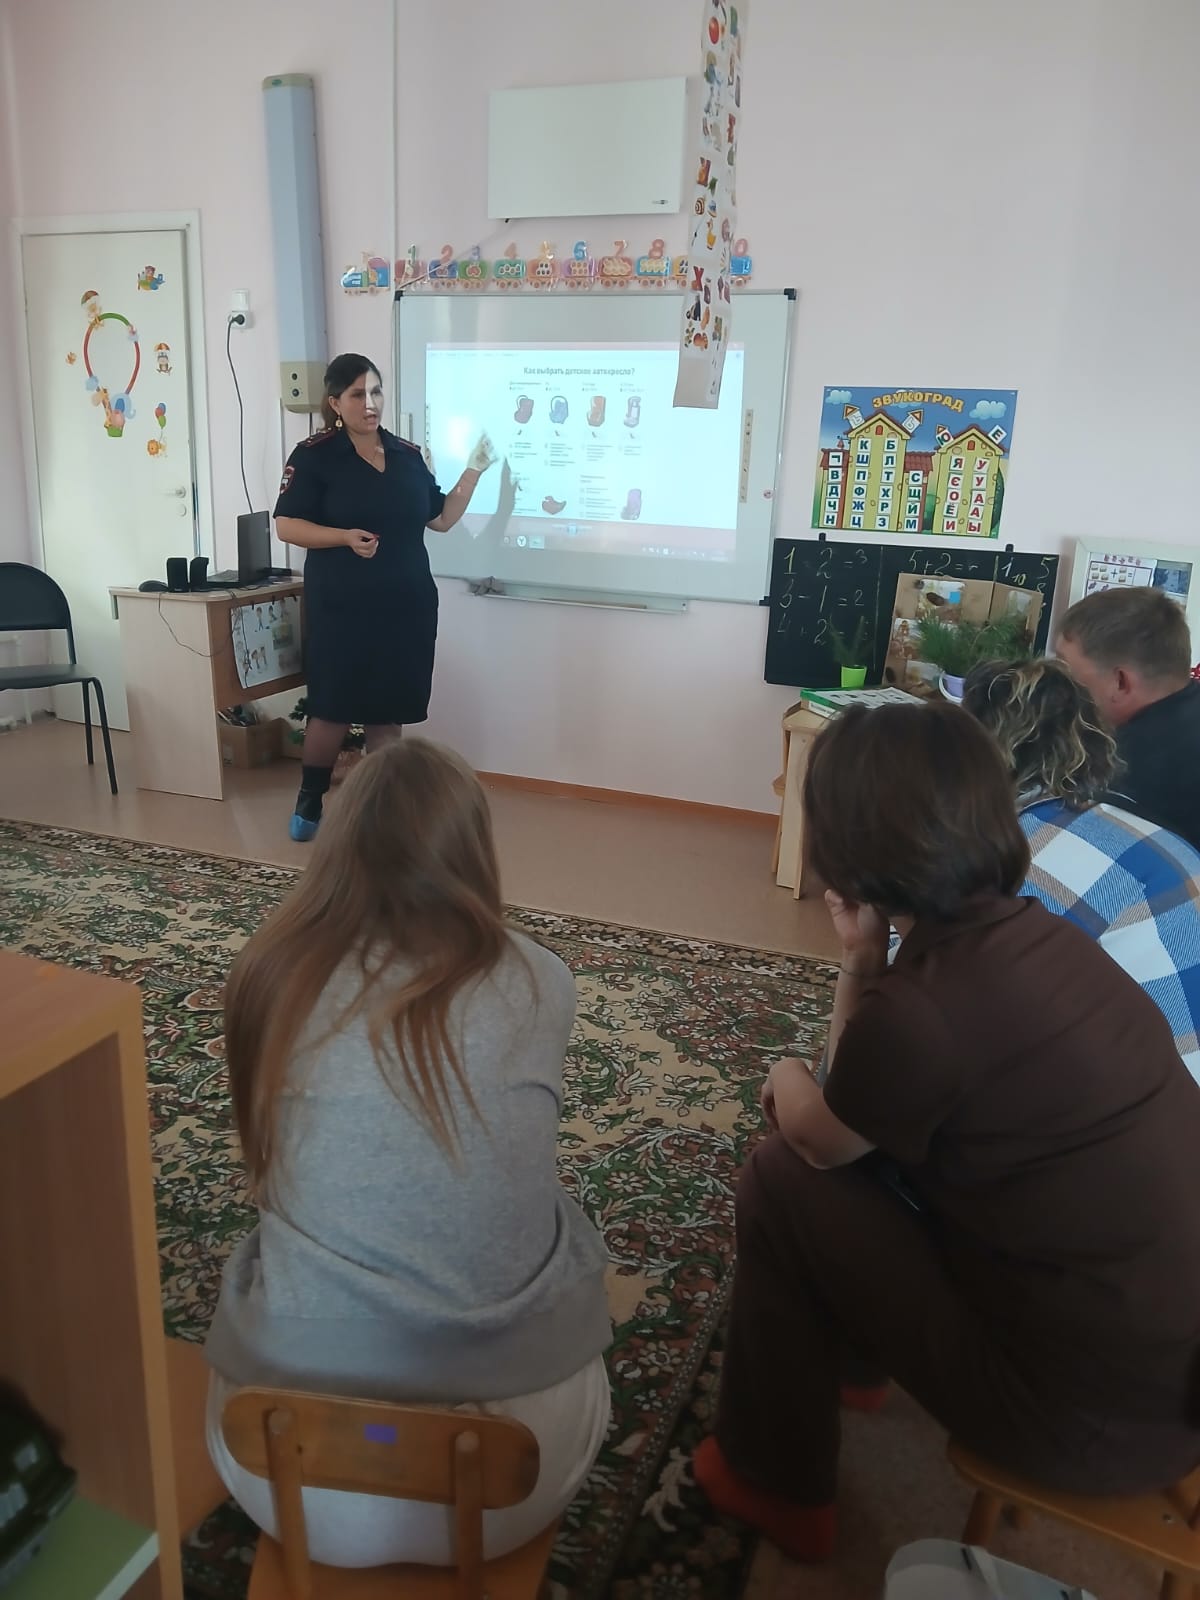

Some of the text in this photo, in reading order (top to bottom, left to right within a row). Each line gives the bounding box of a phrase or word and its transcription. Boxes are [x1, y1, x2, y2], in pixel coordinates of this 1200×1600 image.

[440, 244, 453, 264] 2
[504, 242, 517, 260] 4
[573, 240, 588, 261] 6
[613, 239, 628, 258] 7
[648, 238, 665, 260] 8
[523, 367, 536, 375] Как
[537, 367, 565, 376] выбрать
[565, 368, 592, 376] детское
[872, 391, 965, 413] ЗВУКОГРАД
[937, 432, 951, 446] Ю
[886, 440, 896, 450] Б
[884, 455, 894, 466] Л
[953, 458, 963, 469] Я
[830, 471, 839, 480] В
[884, 471, 894, 481] Т
[911, 472, 921, 483] С
[851, 440, 869, 528] К Ш П Ф Ж Ц
[828, 486, 839, 497] Д
[881, 488, 891, 498] Х
[908, 488, 921, 499] Щ
[949, 491, 959, 501] О
[967, 459, 987, 533] У У А А Ы
[827, 500, 837, 510] Ч
[880, 502, 889, 512] Р
[825, 515, 835, 525] Н
[905, 519, 917, 529] М
[945, 521, 956, 530] И
[783, 546, 797, 575] 1
[816, 547, 833, 579] 2
[855, 548, 868, 564] 3
[908, 550, 924, 572] 5
[934, 552, 951, 577] 2
[1001, 556, 1014, 578] 1
[1036, 556, 1057, 579] 5
[1011, 573, 1027, 586] 10
[854, 589, 865, 606] 2
[813, 618, 827, 646] 2
